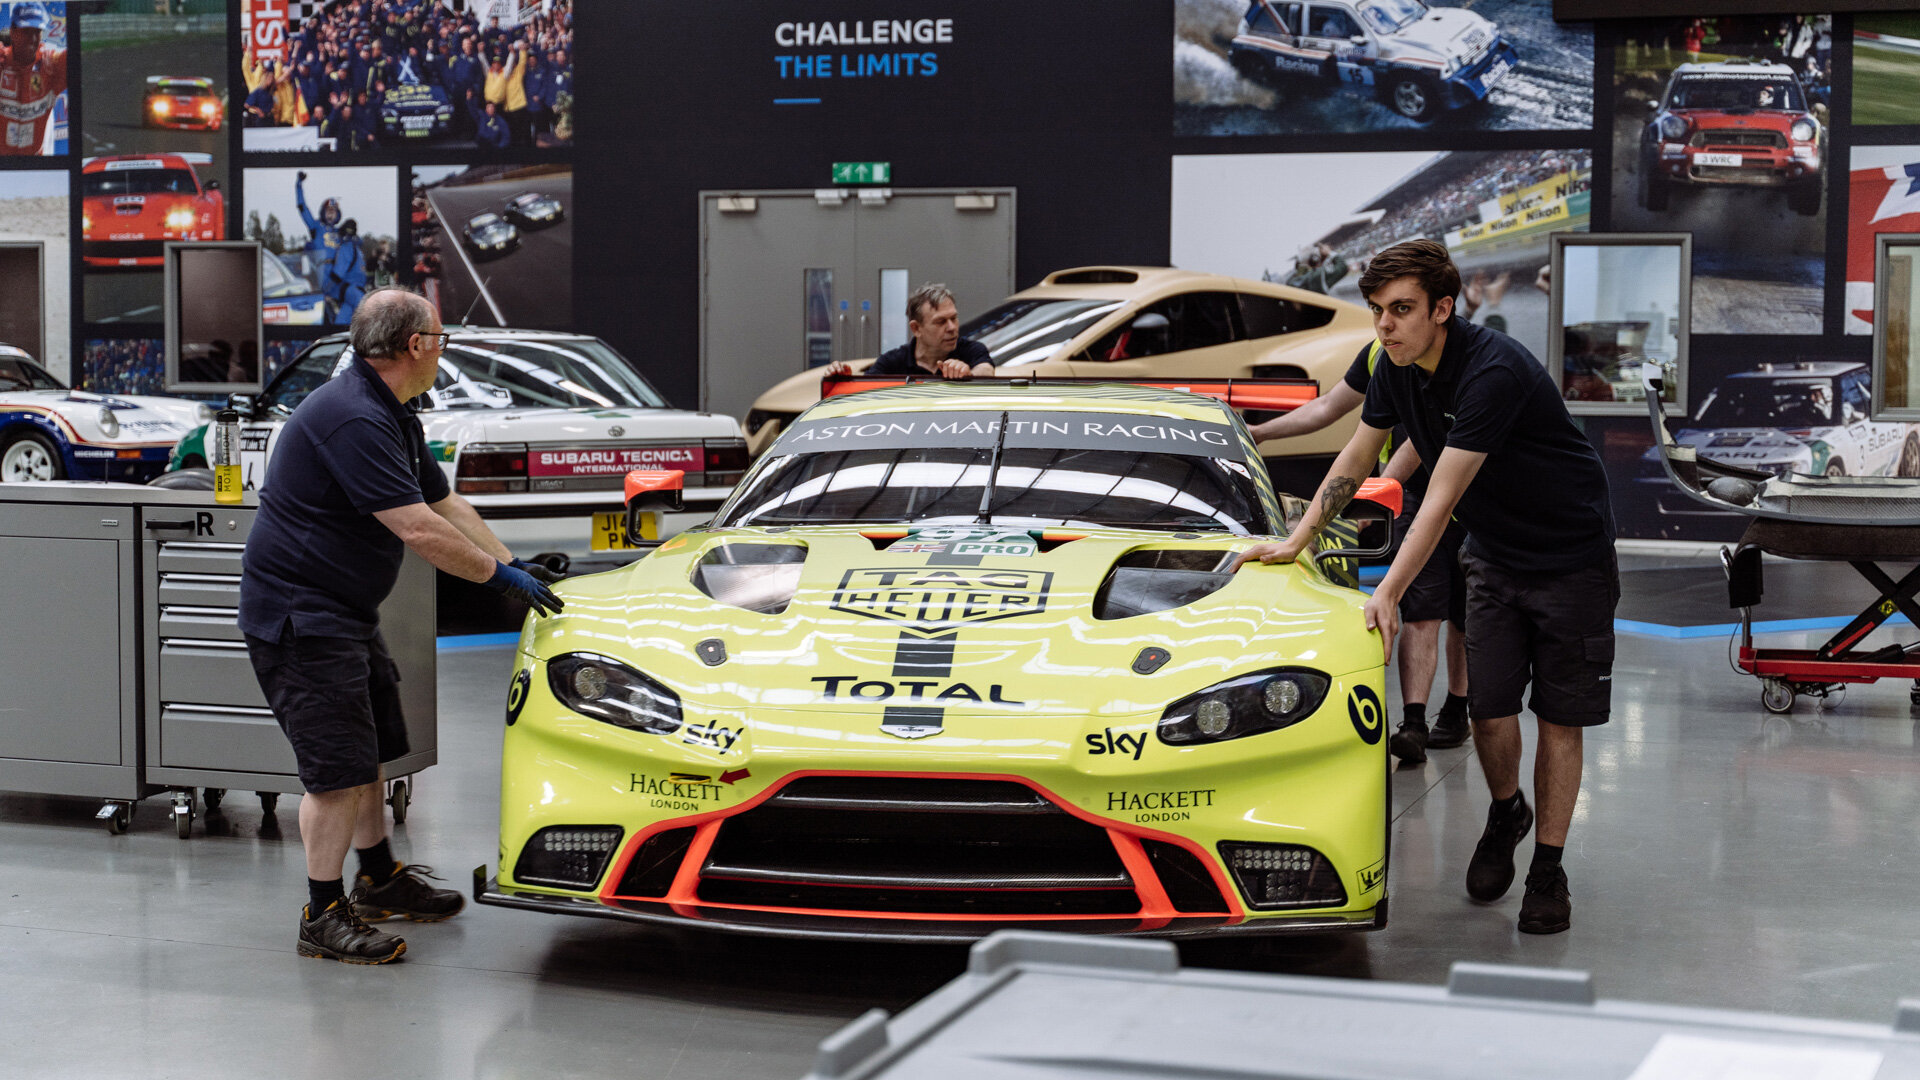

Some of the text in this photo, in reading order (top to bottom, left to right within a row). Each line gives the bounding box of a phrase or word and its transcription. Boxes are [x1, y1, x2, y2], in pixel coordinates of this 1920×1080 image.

[775, 19, 953, 47] CHALLENGE
[774, 52, 938, 79] THE LIMITS
[1275, 55, 1320, 76] Racing
[1491, 217, 1518, 231] Nikon
[1526, 205, 1562, 222] Nikon
[791, 420, 1229, 447] ASTON MARTIN RACING
[1868, 427, 1904, 452] SUBARU
[74, 450, 115, 458] MICHELIN
[223, 433, 232, 492] MOTIVATION
[541, 449, 694, 465] SUBARU TECNICA
[573, 463, 665, 474] INTERNATIONAL
[196, 511, 215, 537] R
[958, 544, 1029, 555] PRO
[863, 571, 1030, 589] TAG
[846, 591, 1031, 622] HEUER
[811, 676, 1026, 708] TOTAL
[682, 719, 745, 755] sky
[1086, 727, 1148, 761] sky
[630, 772, 724, 801] HACKETT
[650, 799, 699, 811] LONDON
[1106, 789, 1217, 811] HACKETT
[1135, 811, 1190, 823] LONDON
